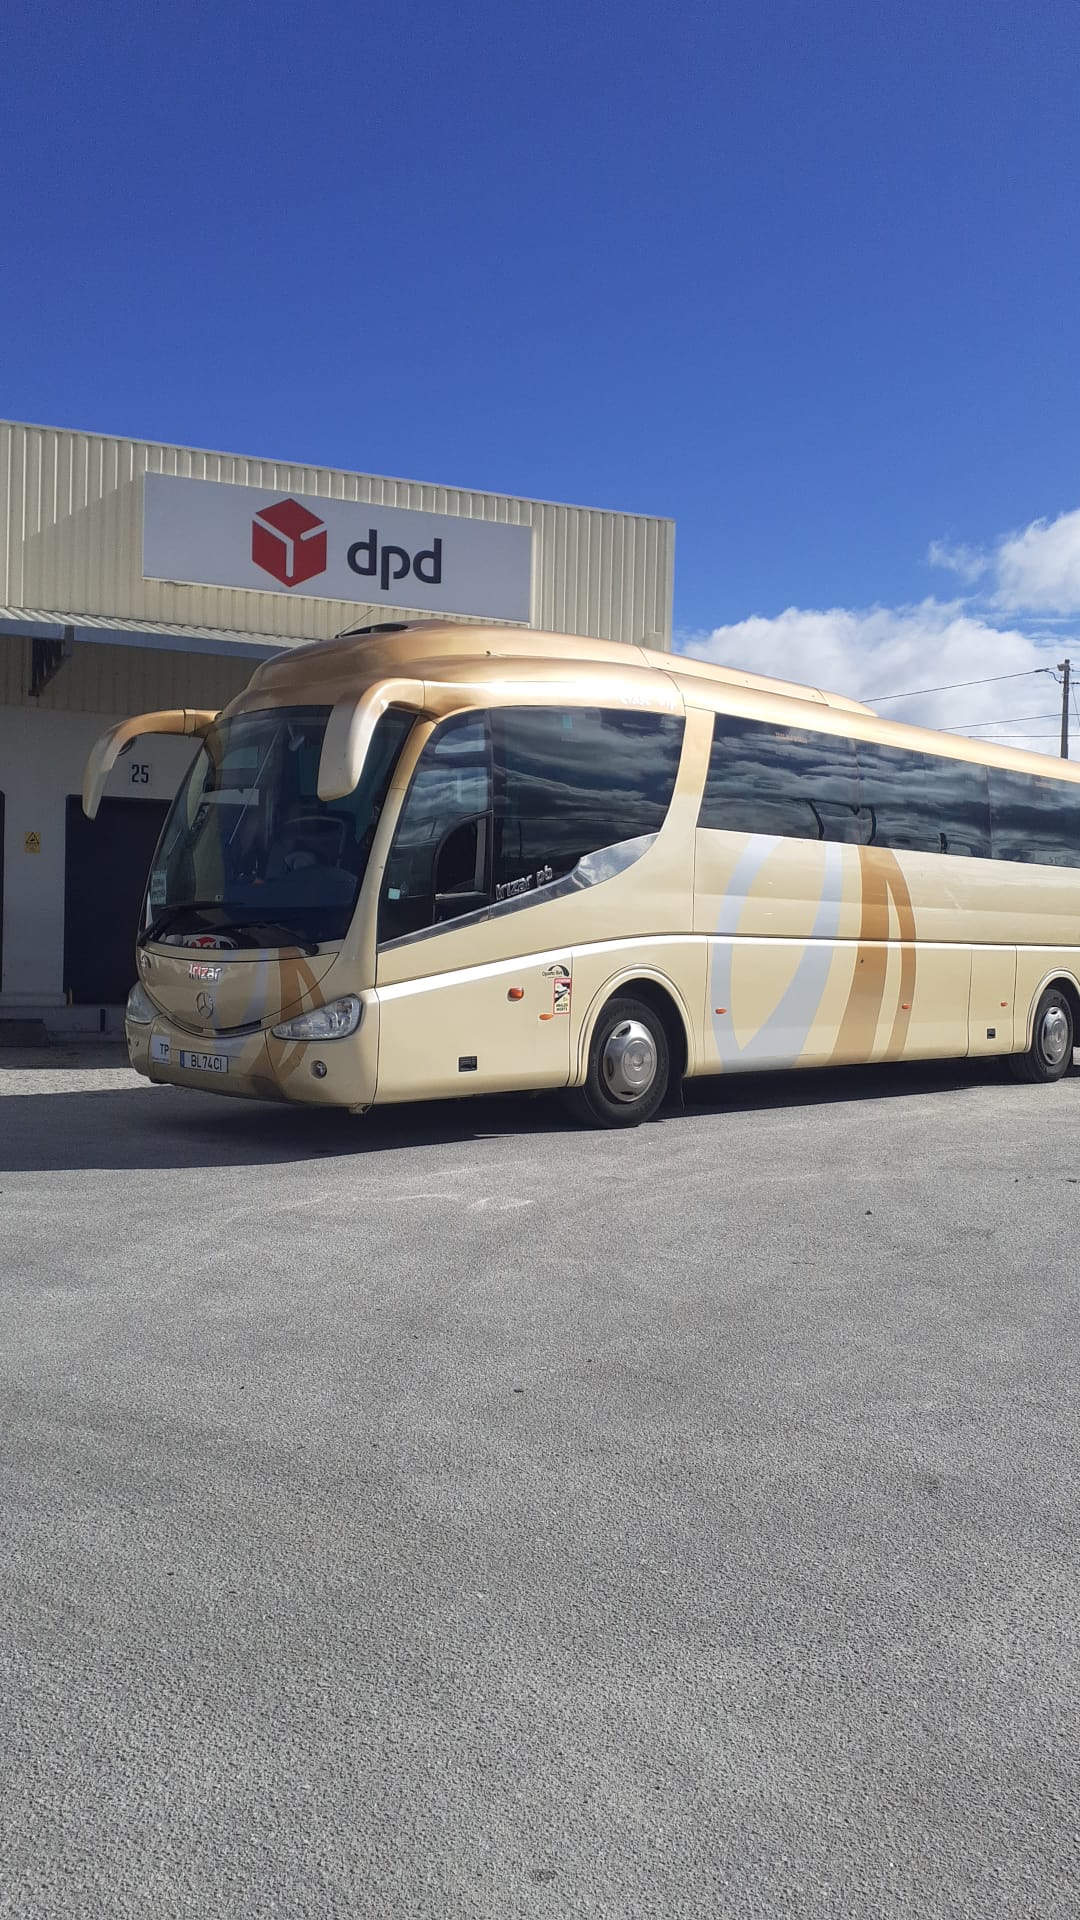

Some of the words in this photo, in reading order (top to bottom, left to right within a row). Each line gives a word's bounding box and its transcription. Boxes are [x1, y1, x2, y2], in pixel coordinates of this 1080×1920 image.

[346, 528, 442, 591] dpd
[131, 764, 150, 784] 25
[160, 1043, 169, 1056] TP
